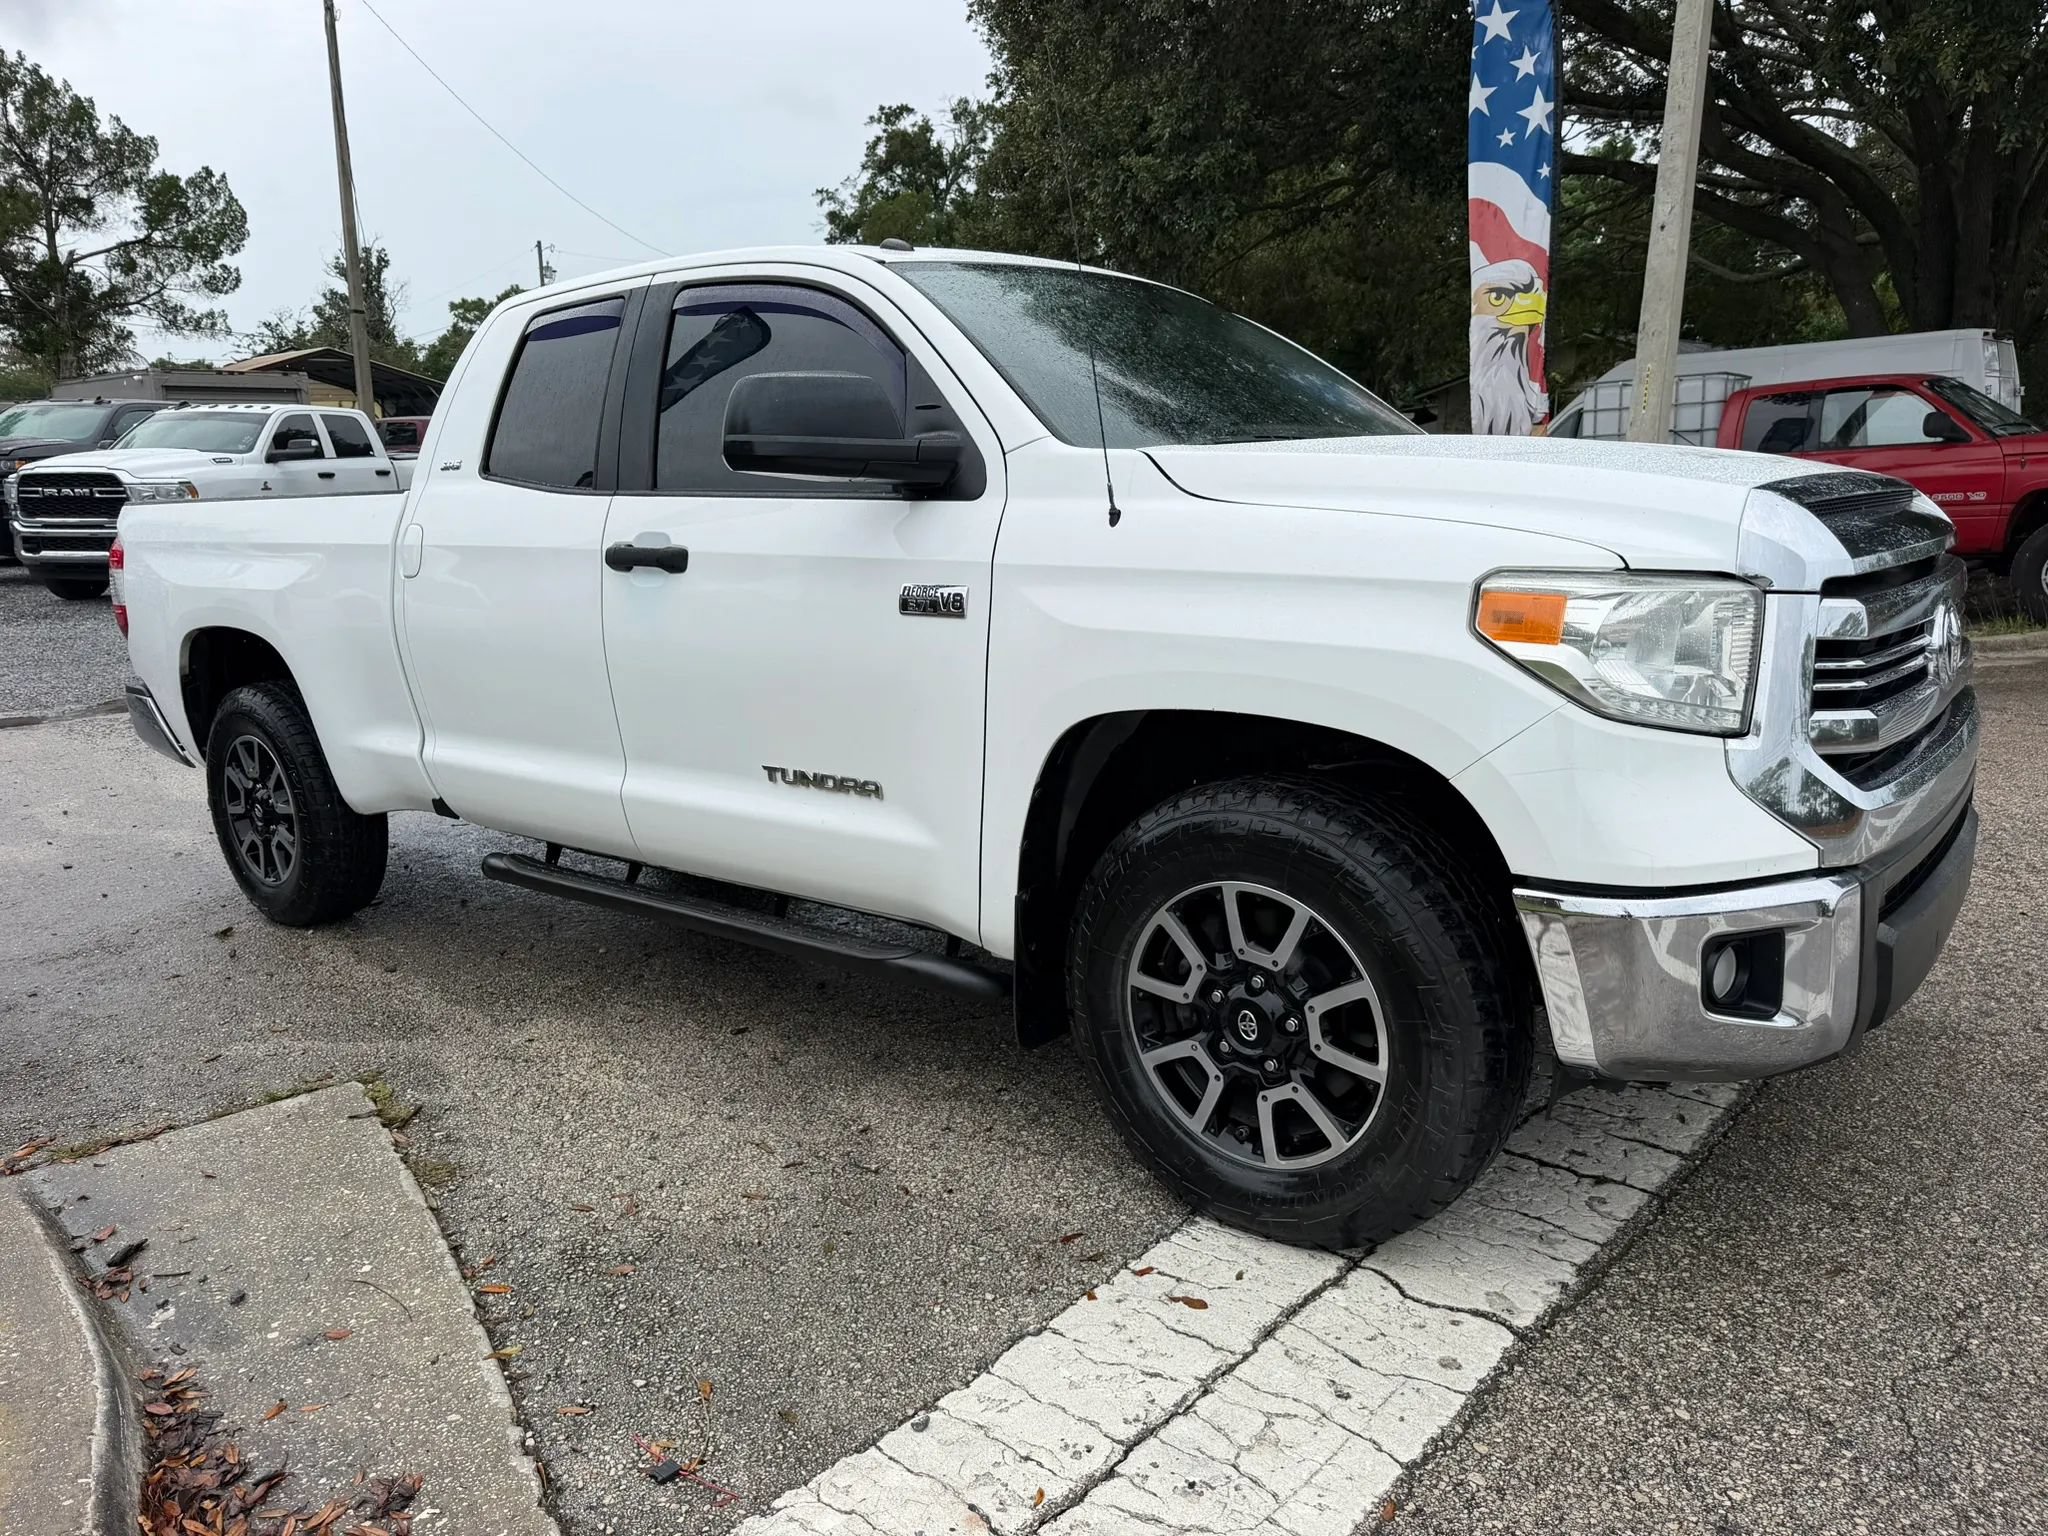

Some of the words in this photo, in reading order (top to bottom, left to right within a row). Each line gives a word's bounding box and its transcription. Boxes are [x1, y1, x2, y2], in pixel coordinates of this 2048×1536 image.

[43, 488, 90, 497] RAM
[940, 592, 965, 612] V8
[761, 764, 884, 801] TUNDRA
